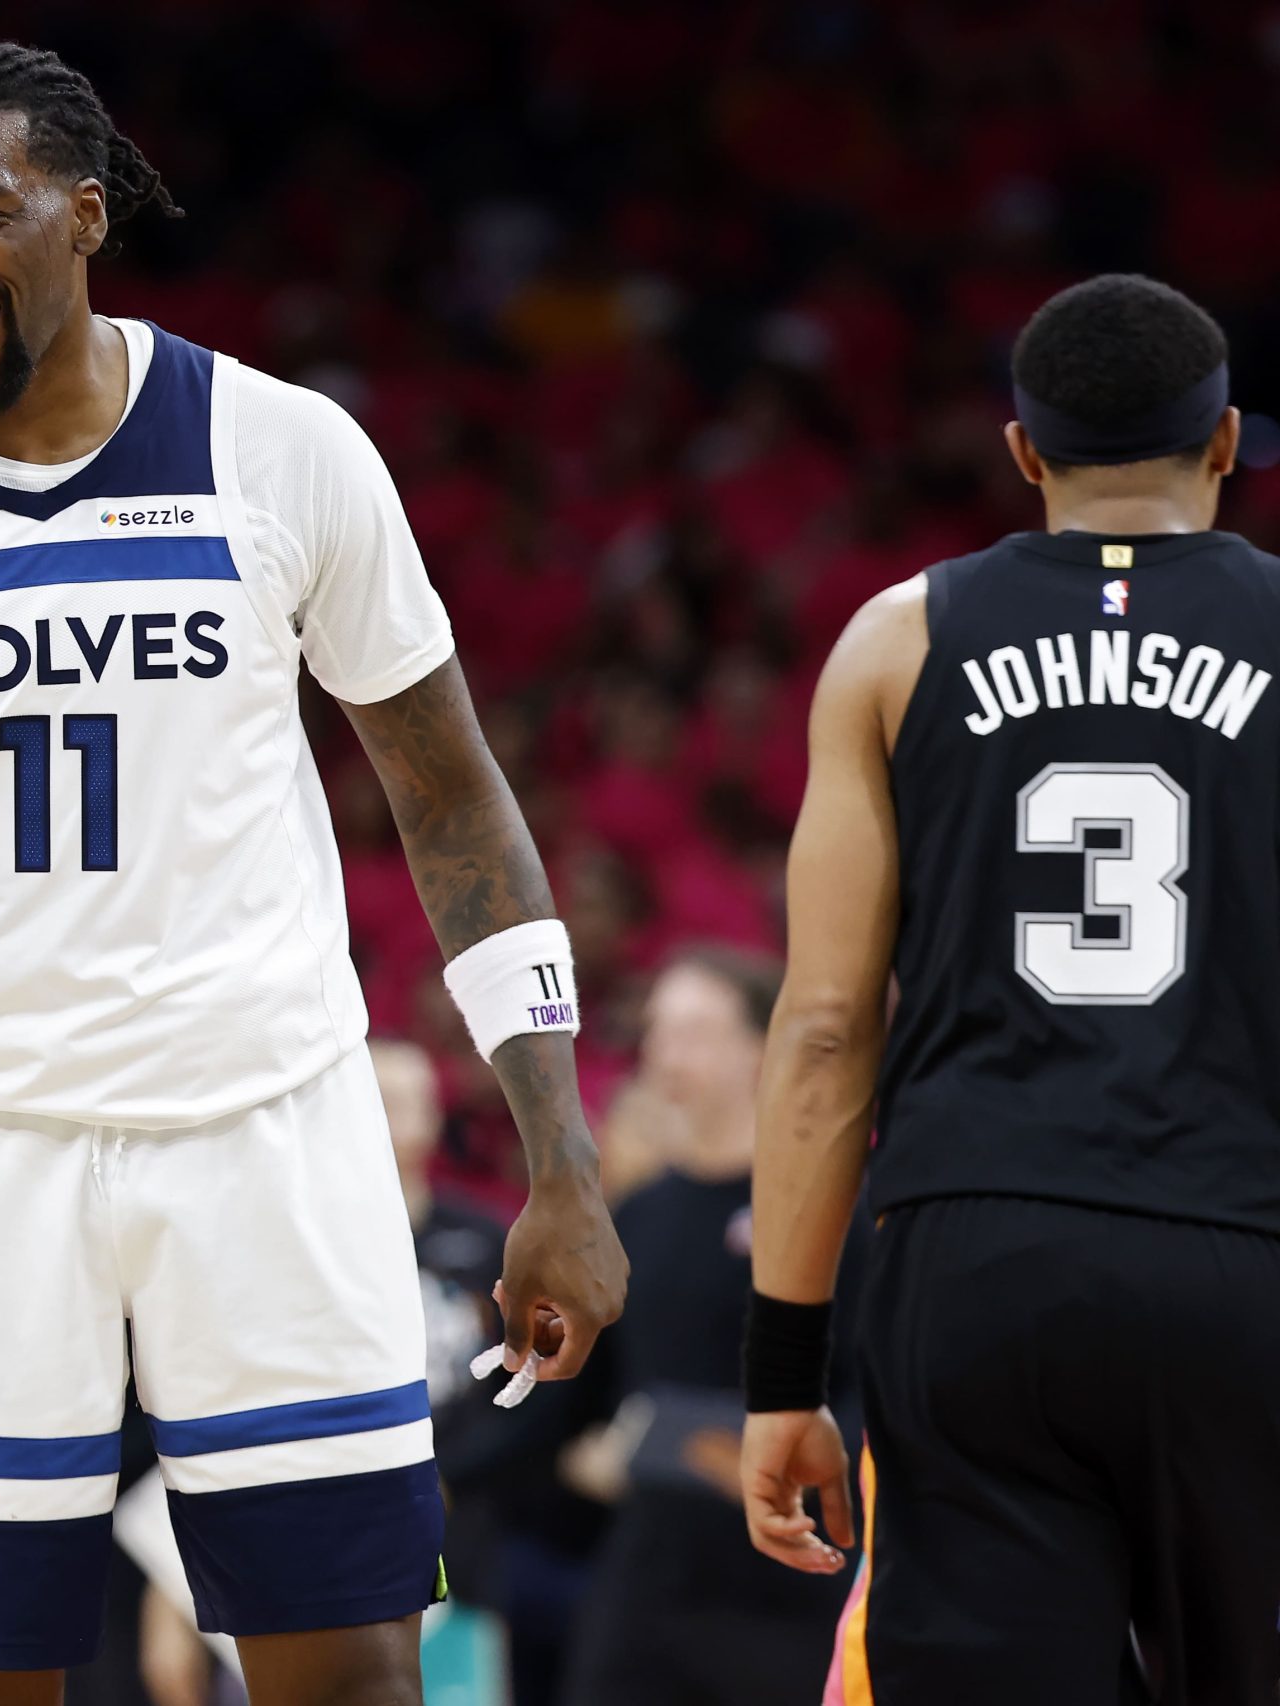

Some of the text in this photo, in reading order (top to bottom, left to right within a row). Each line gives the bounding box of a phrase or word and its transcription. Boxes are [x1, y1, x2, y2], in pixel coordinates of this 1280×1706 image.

[119, 505, 195, 527] sezzle
[962, 630, 1273, 740] JOHNSON
[1016, 762, 1190, 1005] 3
[531, 963, 562, 1000] 11
